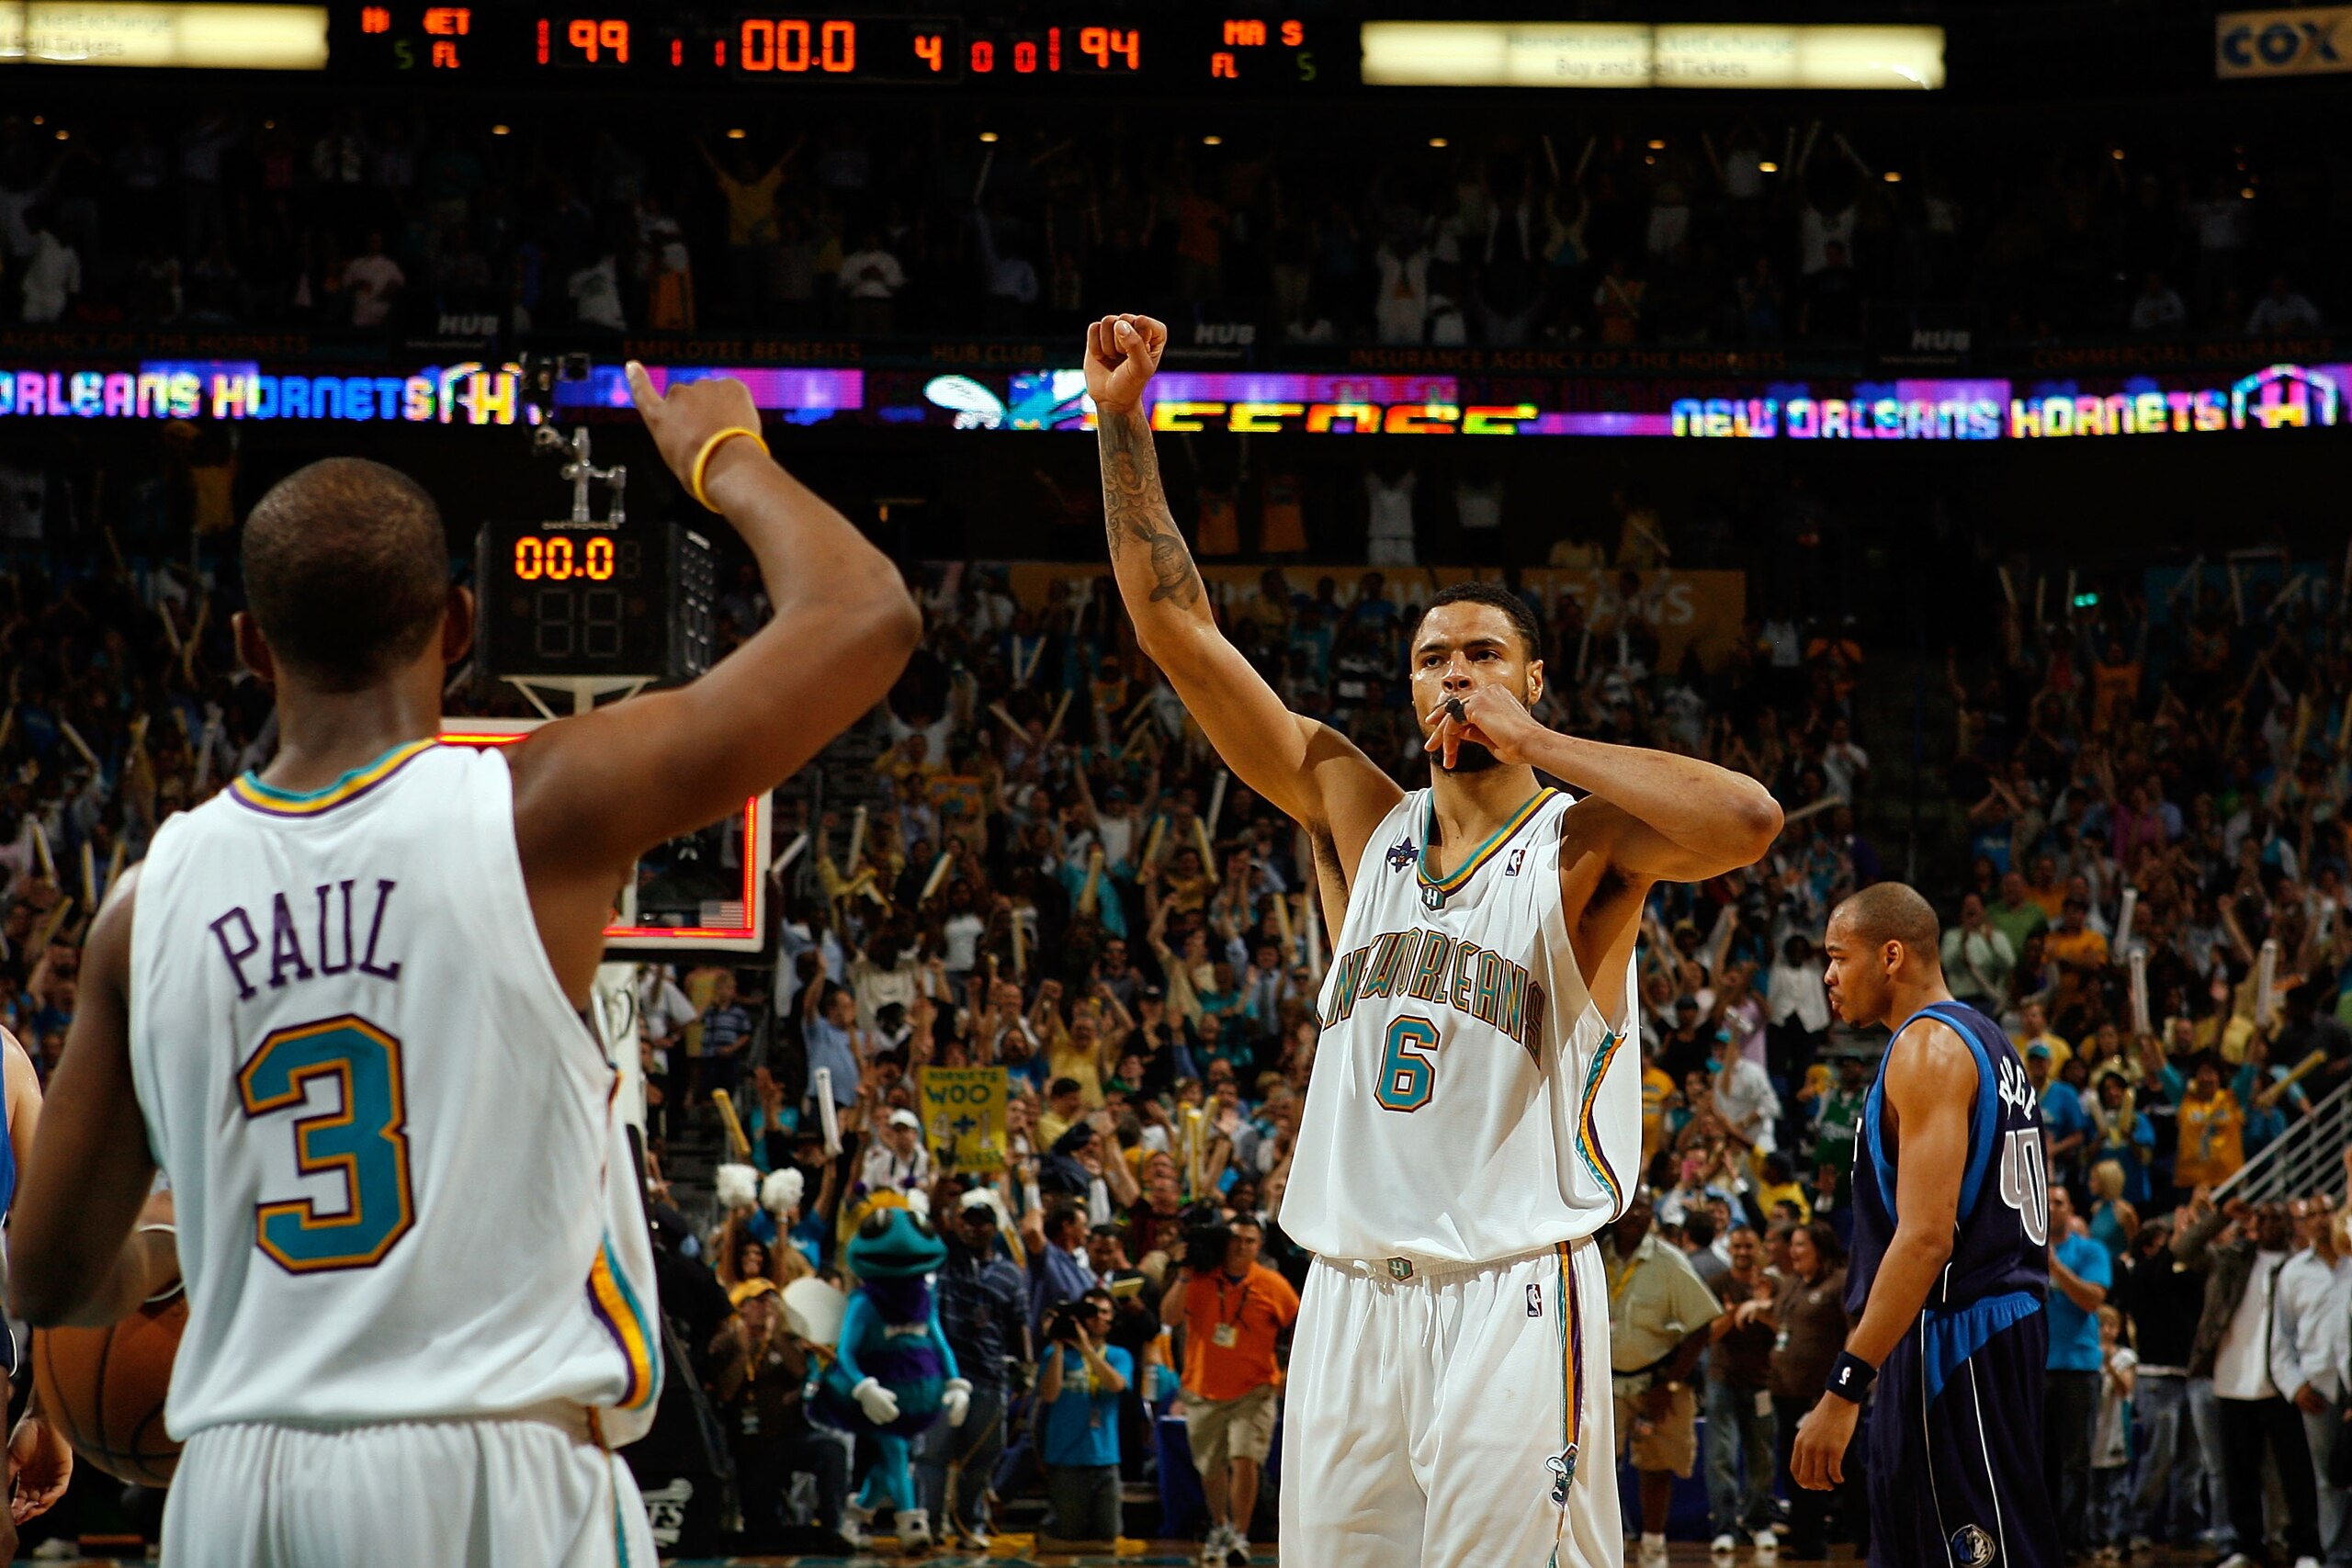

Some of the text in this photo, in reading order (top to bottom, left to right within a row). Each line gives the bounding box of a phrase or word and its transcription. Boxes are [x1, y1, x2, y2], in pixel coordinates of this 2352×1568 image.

[741, 19, 856, 73] 00.0
[914, 35, 943, 73] 4
[2223, 22, 2340, 66] COX
[1555, 58, 1590, 80] Buy
[1598, 59, 1633, 74] and
[1681, 59, 1749, 78] Tickets
[1193, 323, 1255, 344] HUB
[1349, 349, 1485, 369] INSURANCE
[1490, 350, 1586, 370] AGENCY
[1672, 389, 2230, 439] NEW ORLEANS HORNETS
[515, 536, 615, 581] 00.0
[210, 879, 401, 999] PAUL
[1374, 1015, 1440, 1112] 6
[925, 1085, 991, 1104] WOO
[237, 1013, 415, 1276] 3
